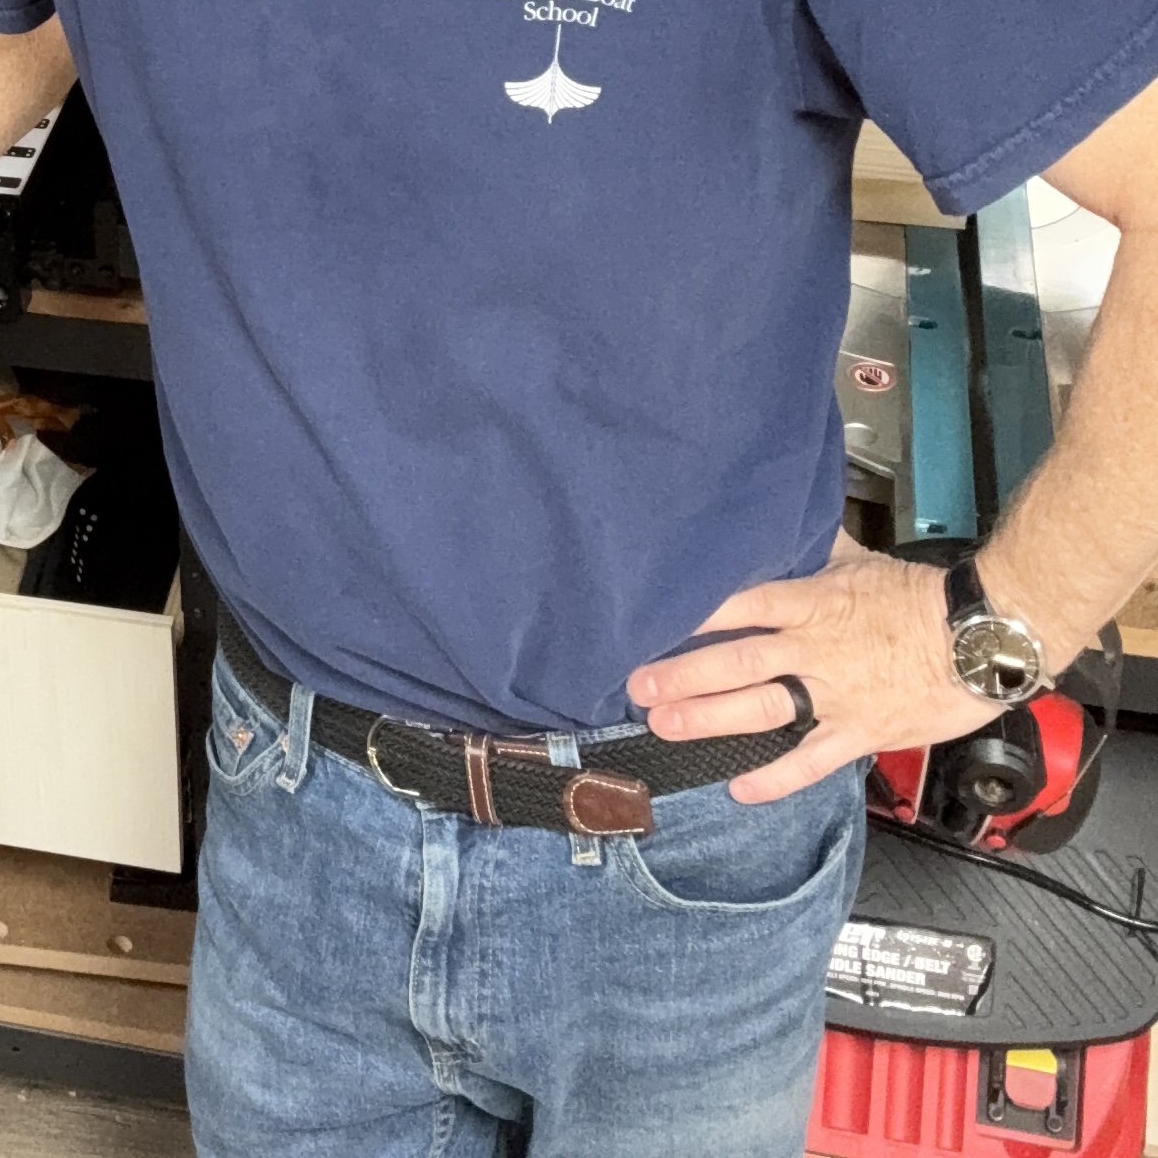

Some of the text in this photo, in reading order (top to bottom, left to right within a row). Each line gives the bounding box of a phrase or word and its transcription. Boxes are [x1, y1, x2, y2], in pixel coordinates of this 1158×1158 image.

[523, 0, 599, 27] School
[862, 947, 900, 966] EDGE
[914, 955, 951, 975] BELT
[865, 963, 926, 987] SANDER
